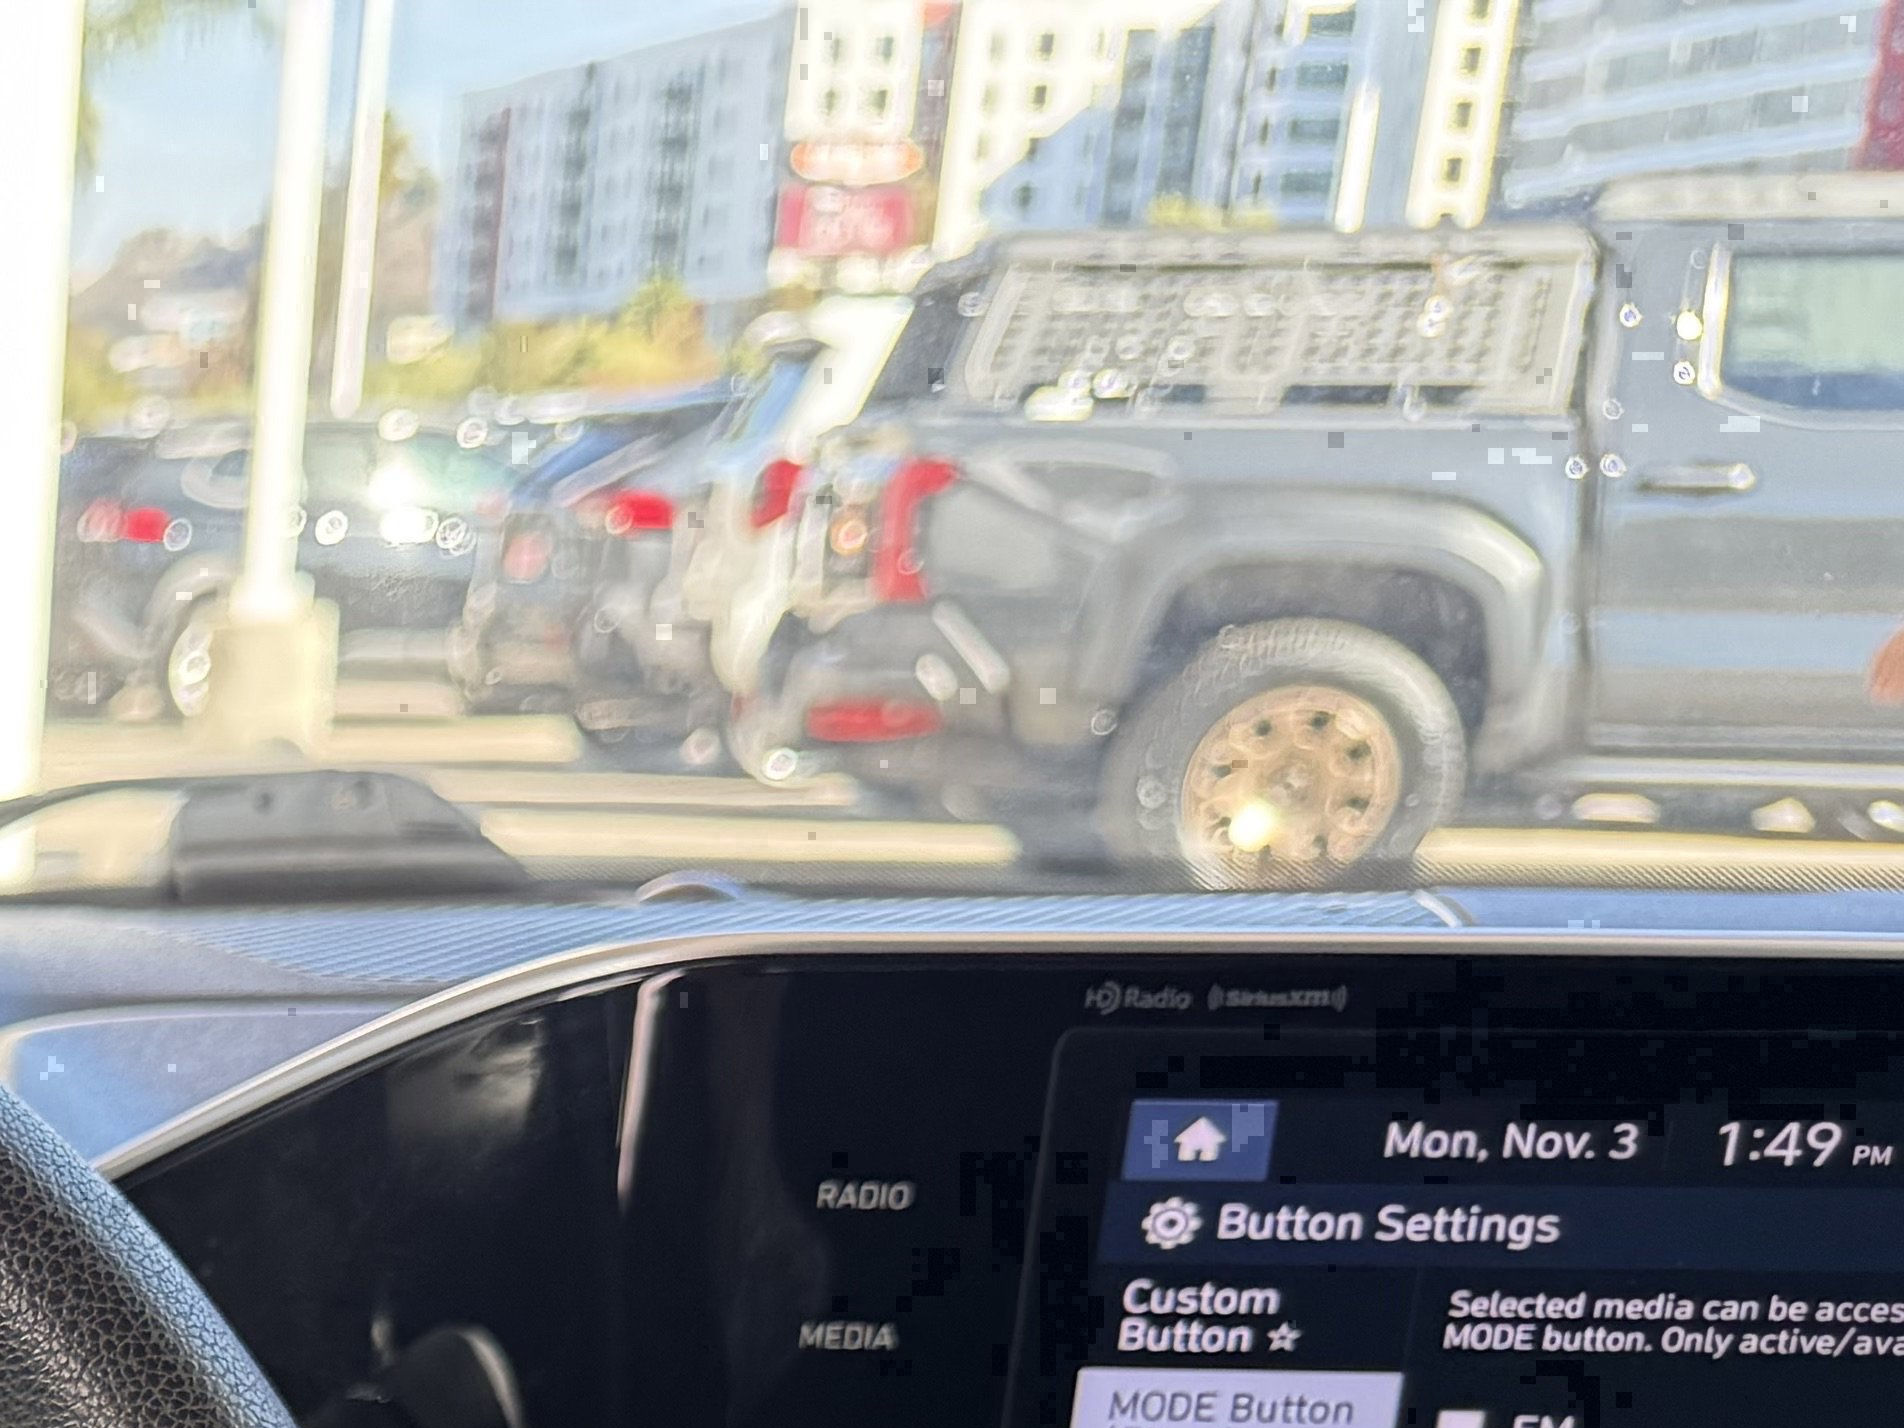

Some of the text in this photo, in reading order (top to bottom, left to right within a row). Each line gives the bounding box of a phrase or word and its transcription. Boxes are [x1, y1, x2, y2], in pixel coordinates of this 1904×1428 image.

[1123, 984, 1194, 1010] Radio
[1383, 1121, 1640, 1163] Mon, Nov. 3
[1718, 1121, 1894, 1168] 1:49 PM
[816, 1179, 916, 1211] RADIO
[1217, 1203, 1561, 1251] Button Settings
[1122, 1277, 1281, 1316] Custom
[1448, 1289, 1587, 1321] Selected
[1592, 1293, 1694, 1321] media
[1702, 1298, 1759, 1322] can
[1768, 1295, 1808, 1323] be
[798, 1320, 900, 1350] MEDIA
[1117, 1316, 1253, 1353] Button
[1442, 1323, 1536, 1351] MODE
[1541, 1325, 1653, 1353] button.
[1661, 1327, 1733, 1359] Only
[1108, 1390, 1355, 1425] MODE Button
